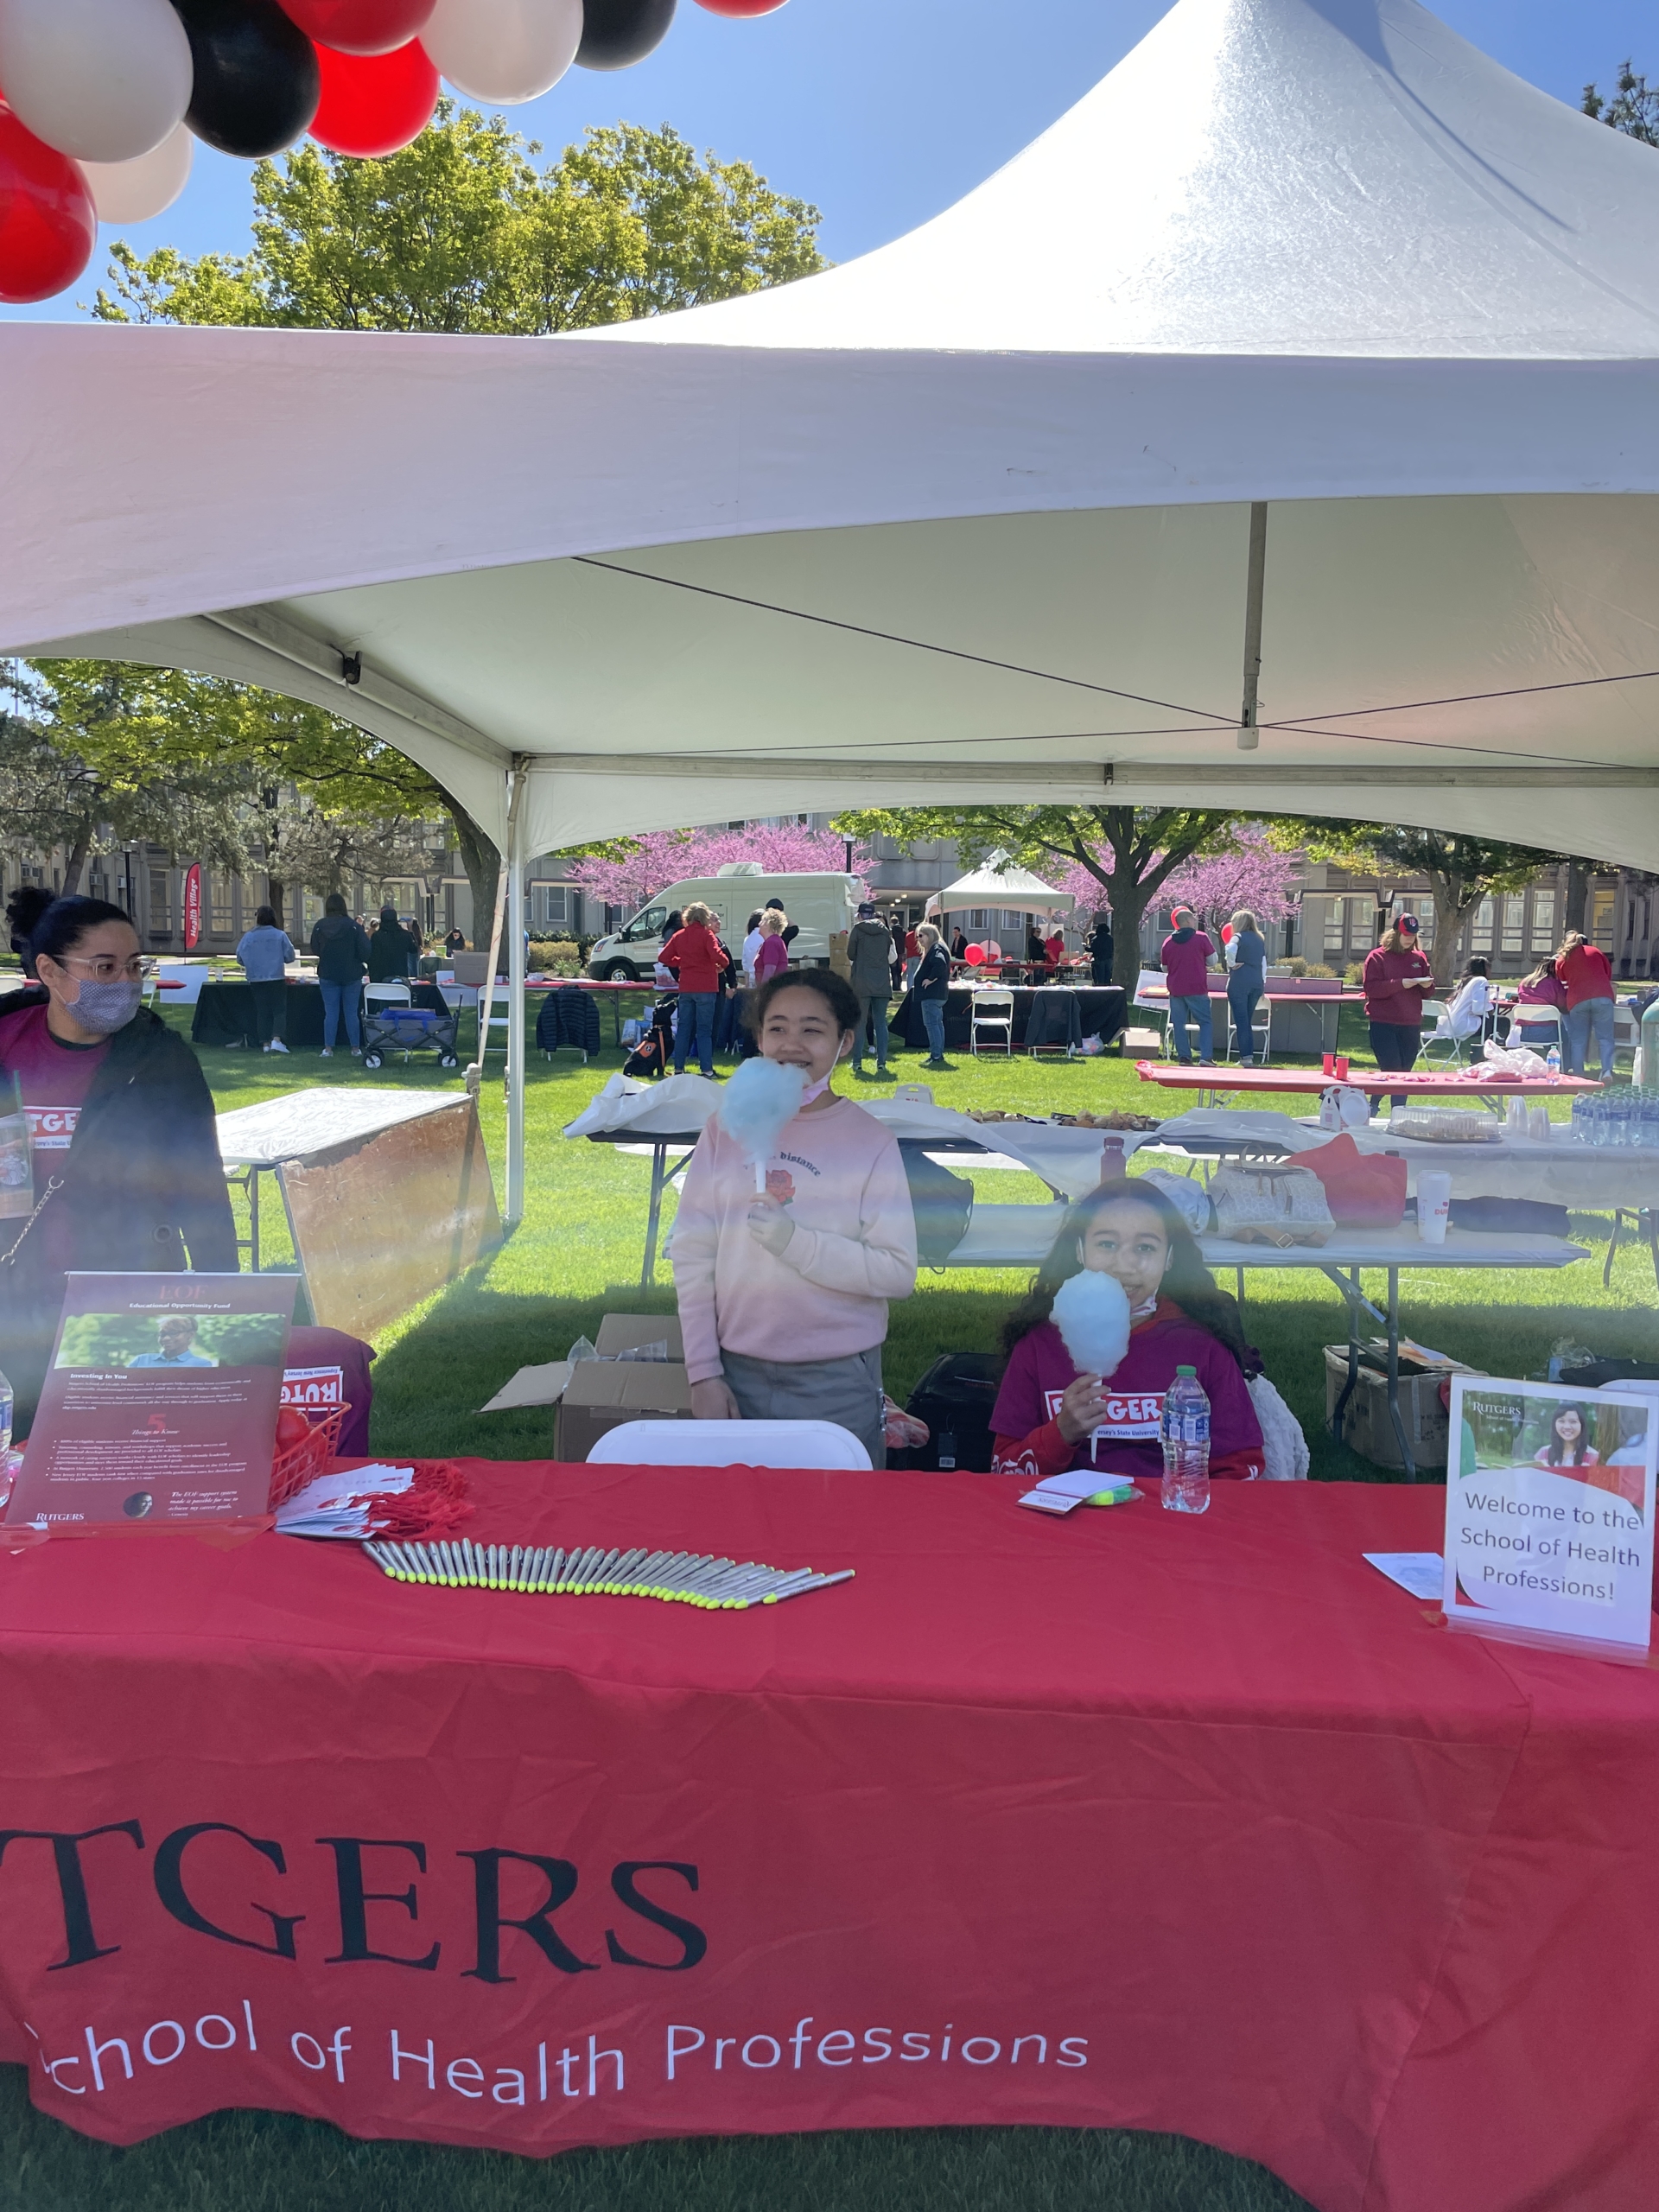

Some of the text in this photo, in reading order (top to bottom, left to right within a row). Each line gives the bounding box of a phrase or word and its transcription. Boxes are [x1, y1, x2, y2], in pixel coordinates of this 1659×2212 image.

[189, 878, 199, 937] Health Village
[780, 1151, 821, 1177] distance
[160, 1285, 208, 1300] EOF
[1472, 1401, 1522, 1416] RUTGERS
[148, 1413, 167, 1433] 5
[1132, 1428, 1160, 1438] University
[199, 1490, 219, 1498] support
[1465, 1491, 1639, 1530] Welcome to the
[1460, 1527, 1640, 1567] School of Health
[1484, 1566, 1614, 1600] Professions!
[291, 2026, 352, 2082] of
[391, 2029, 625, 2106] Health
[666, 2017, 1089, 2080] Professions
